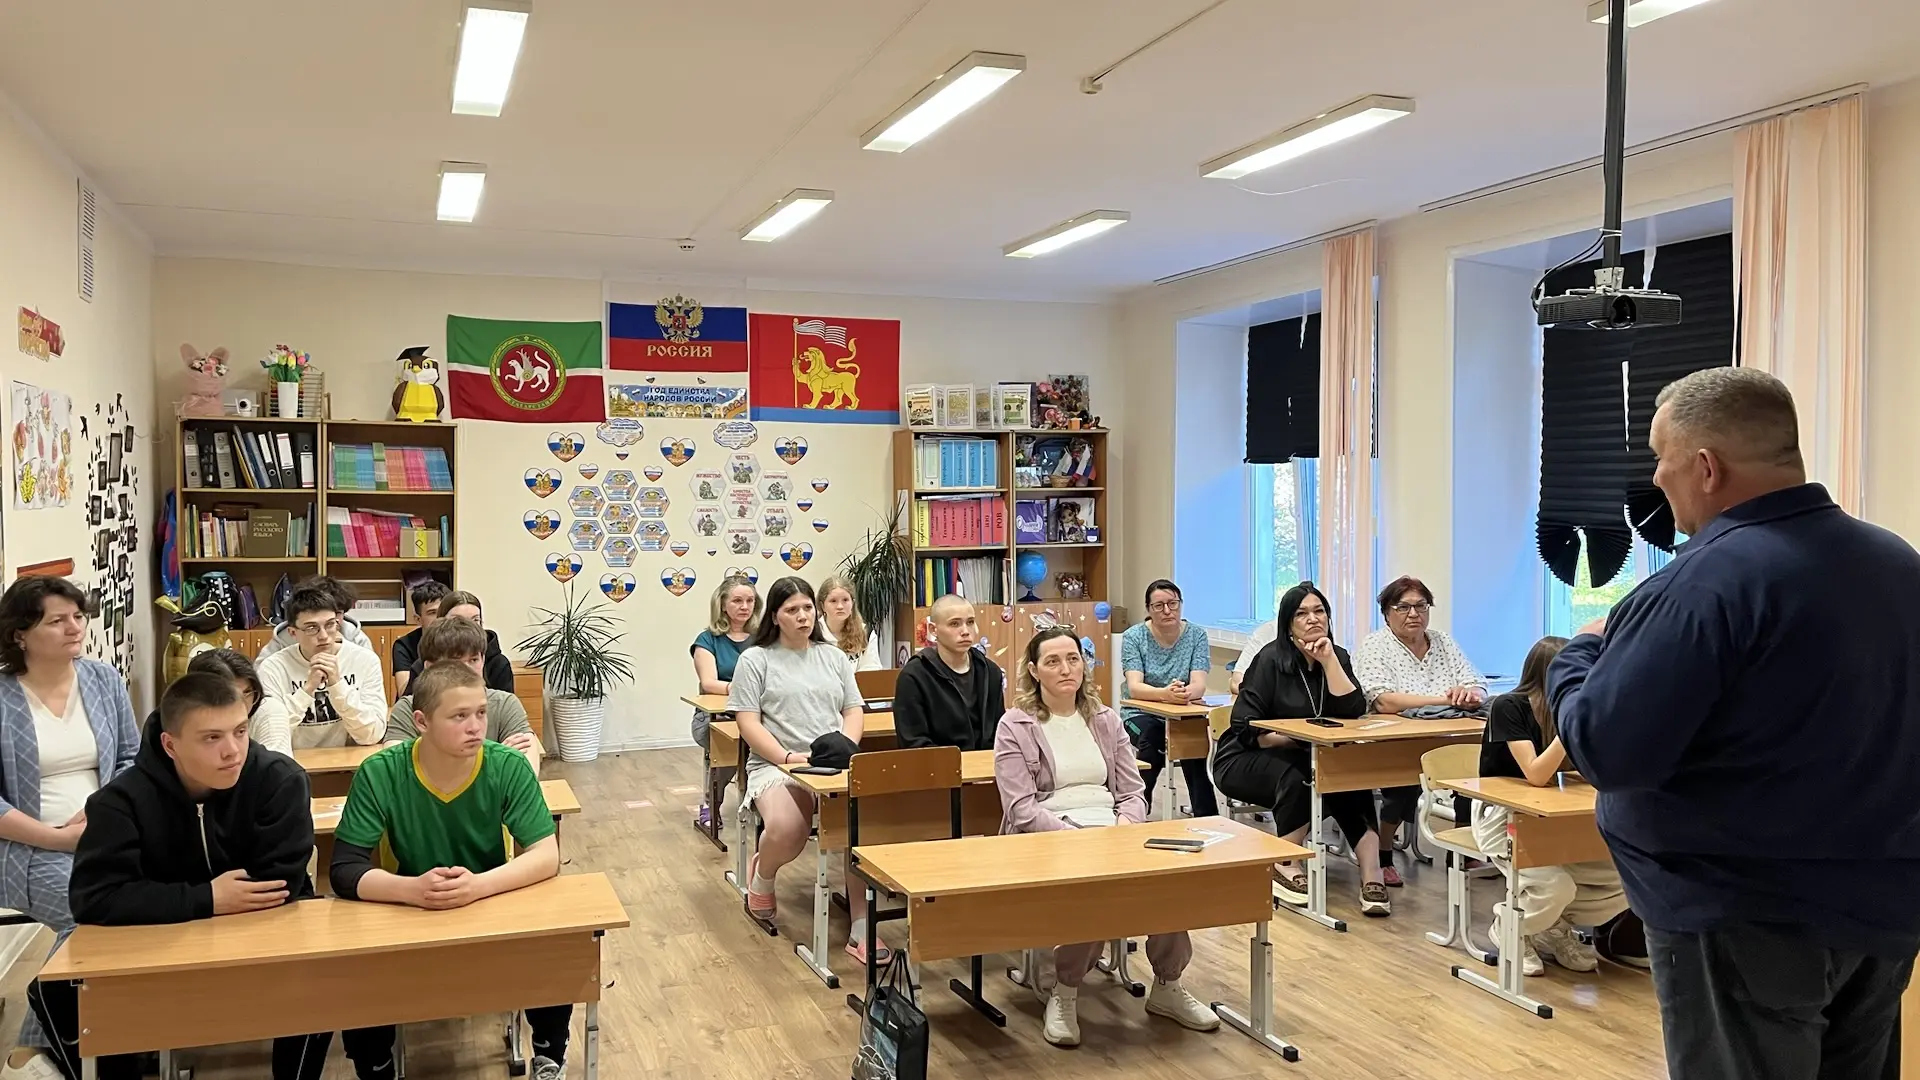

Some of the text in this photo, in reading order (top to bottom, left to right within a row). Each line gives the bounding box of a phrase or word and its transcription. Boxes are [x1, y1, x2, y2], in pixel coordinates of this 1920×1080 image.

[646, 344, 713, 358] РОССИЯ
[668, 387, 711, 395] ЕДИНСТВА
[643, 394, 717, 403] НАРОДОВ РОССИИ
